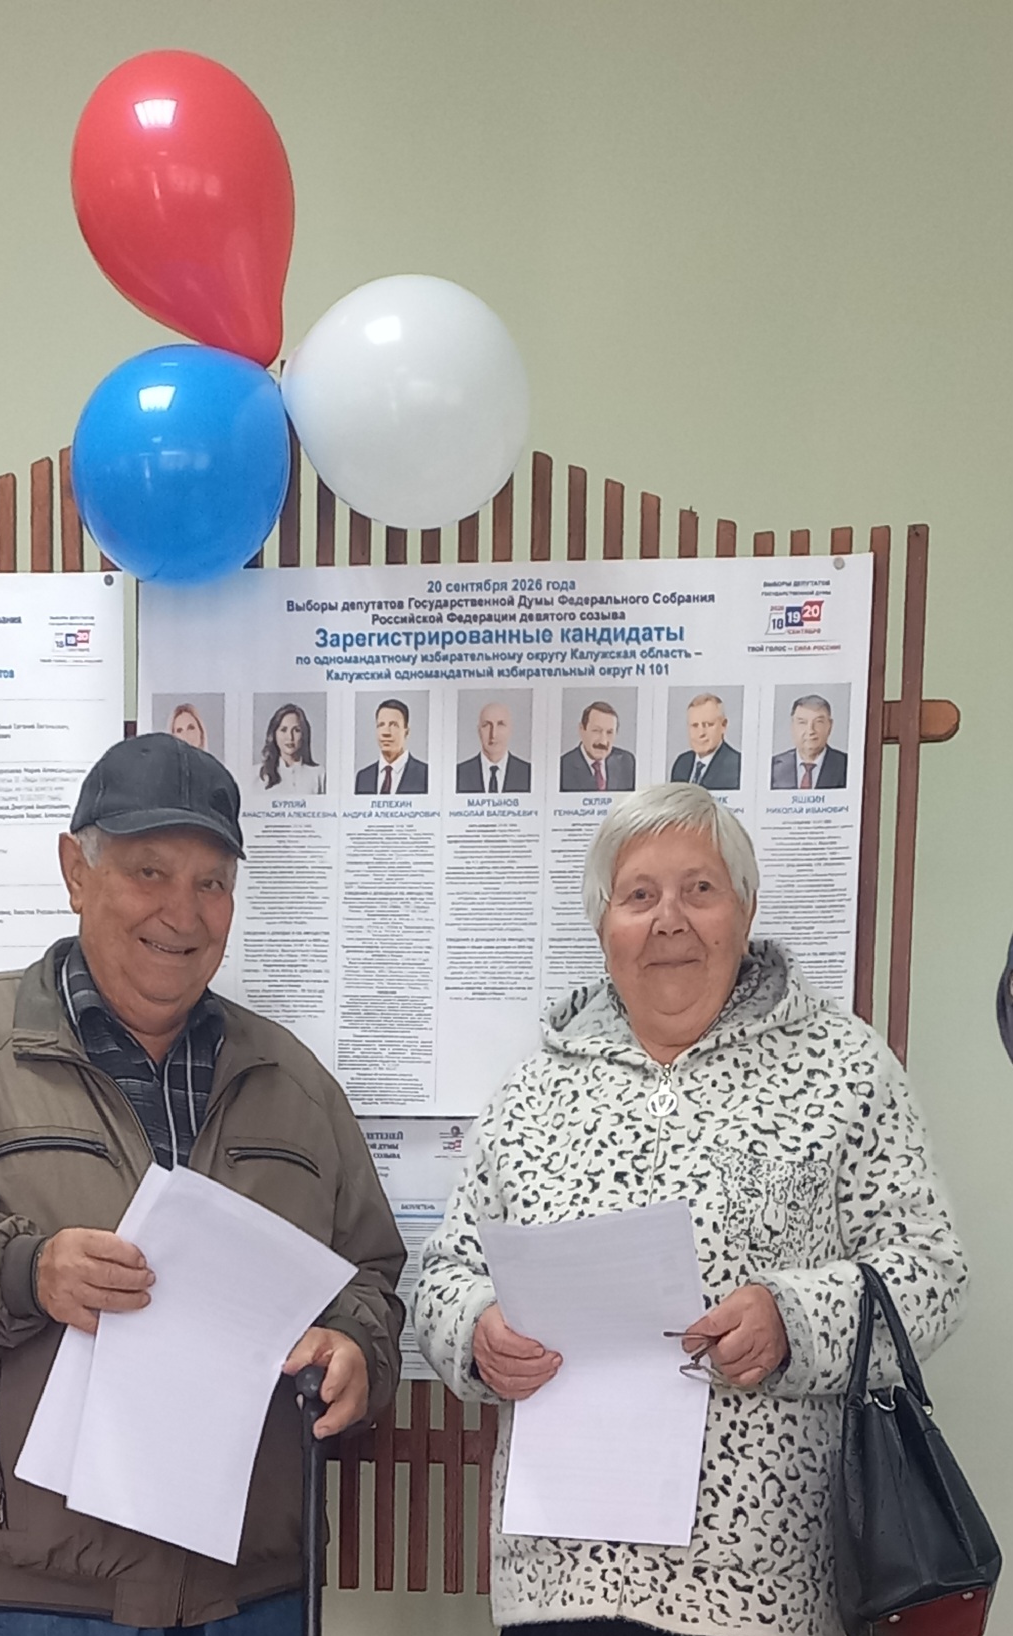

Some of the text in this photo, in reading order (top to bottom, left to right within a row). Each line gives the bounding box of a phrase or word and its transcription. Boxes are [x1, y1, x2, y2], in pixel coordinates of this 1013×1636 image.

[427, 579, 576, 594] 20 сентября 2026 года
[287, 592, 715, 614] Выборы депутатов Государственной Думы Федерального Собрания
[371, 611, 626, 625] Российской Федерации девятого созыва
[772, 605, 820, 630] 18 19 20
[315, 626, 685, 652] Зарегистрированные кандидаты
[296, 647, 691, 666] по одномандатному избирательному округу Калужская область
[327, 663, 670, 683] Калужский одномандатный избирательный округ N 101
[467, 798, 519, 807] МАРТЫНОВ
